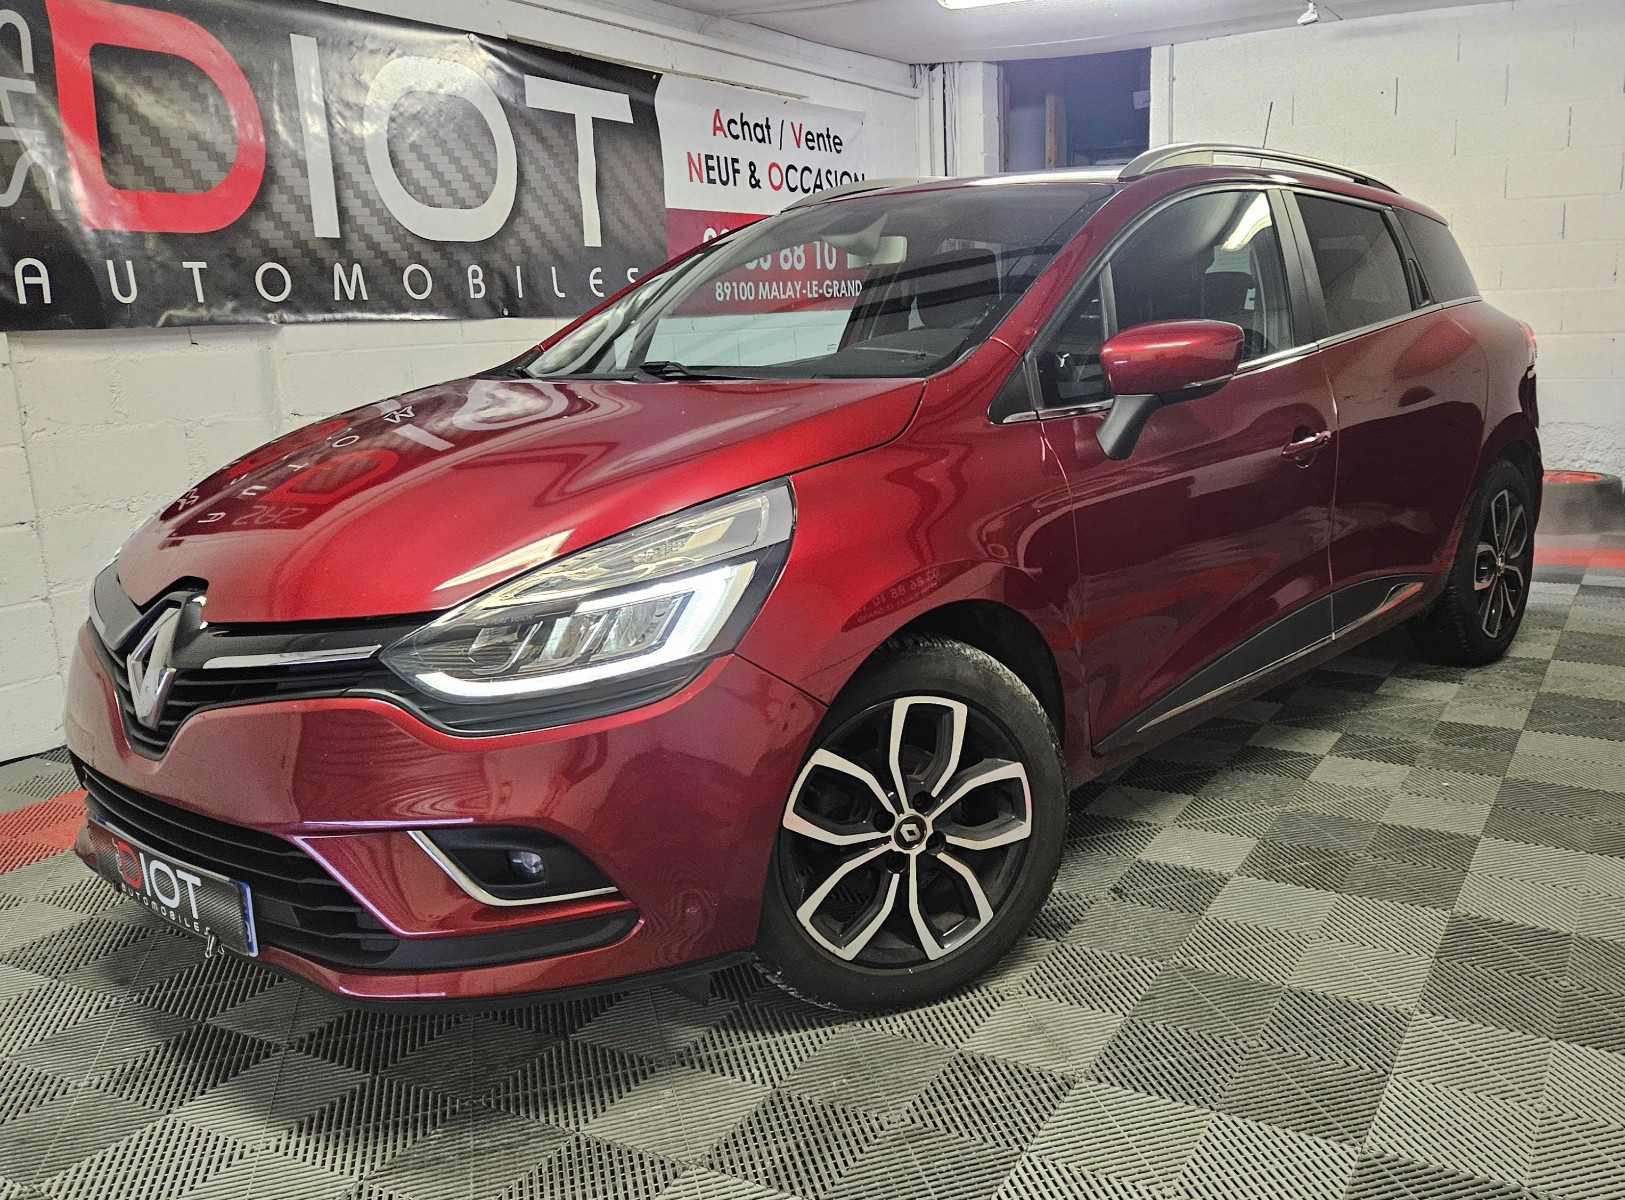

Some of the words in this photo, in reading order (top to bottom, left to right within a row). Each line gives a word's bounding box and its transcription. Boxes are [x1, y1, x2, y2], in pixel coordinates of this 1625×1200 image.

[48, 0, 634, 247] DIOT
[712, 109, 772, 145] Achat
[790, 121, 843, 154] Vente
[687, 151, 741, 187] NEUF
[748, 160, 763, 190] &
[715, 281, 755, 301] 89100
[758, 279, 863, 300] MALAY-LE-GRAND
[116, 839, 202, 920] DIOT
